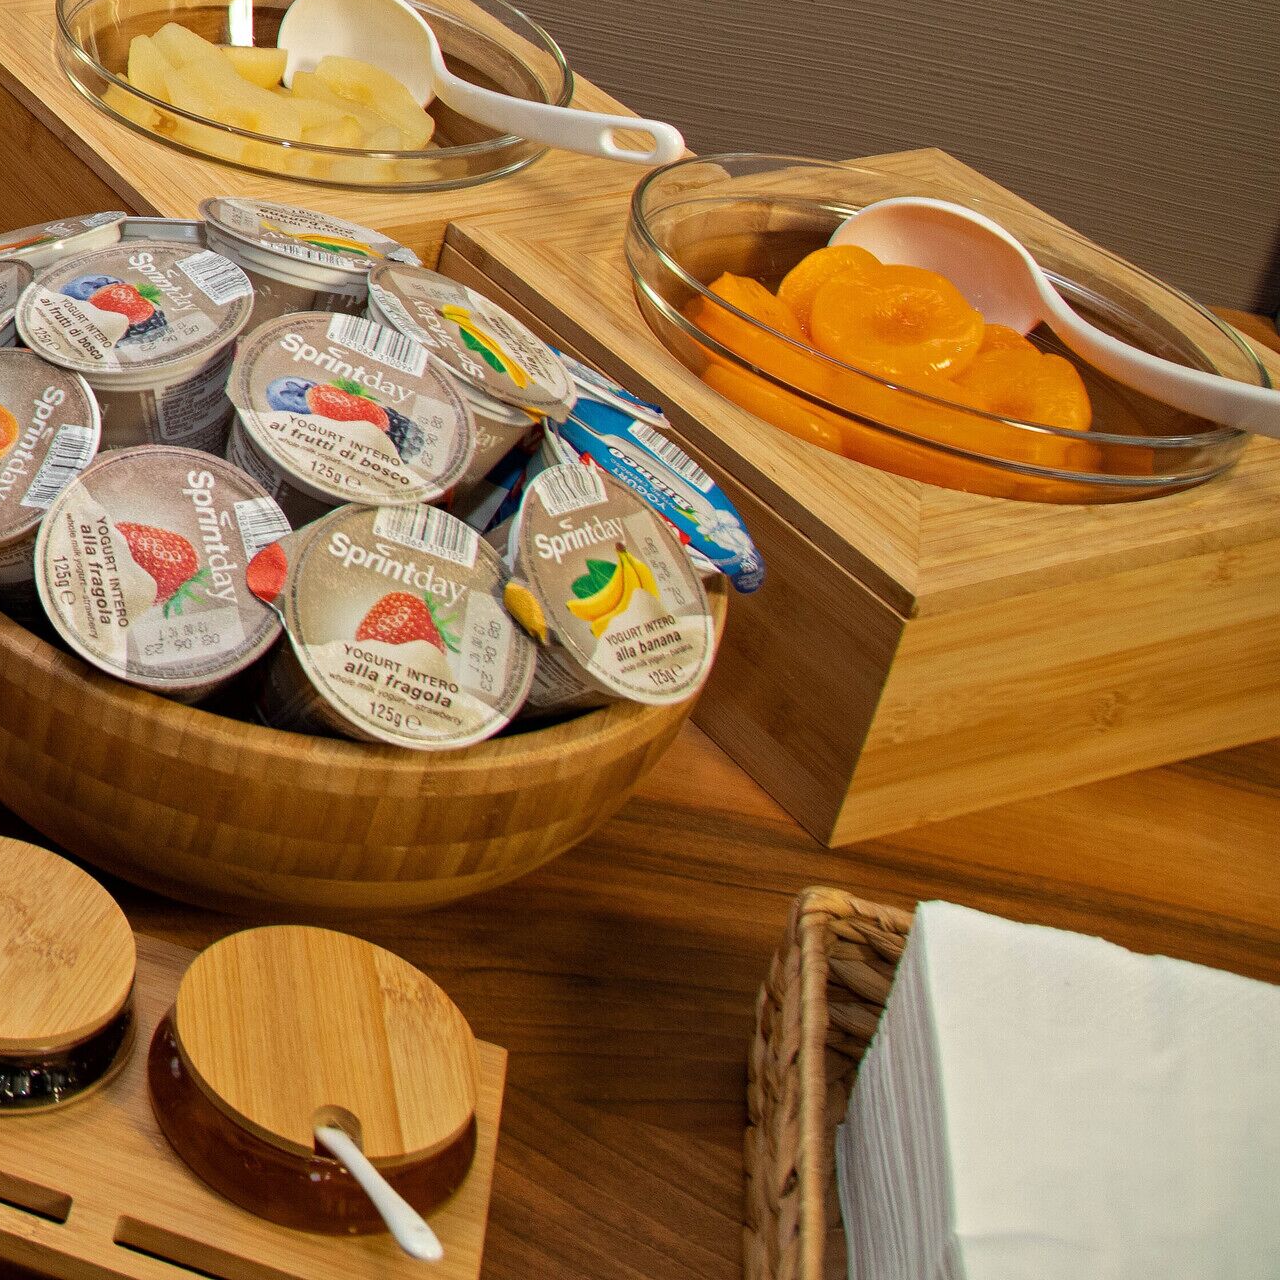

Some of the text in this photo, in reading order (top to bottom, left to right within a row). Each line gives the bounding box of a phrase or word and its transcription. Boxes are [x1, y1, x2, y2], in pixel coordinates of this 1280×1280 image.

[128, 252, 201, 312] Sprintday
[40, 297, 103, 360] ai frutti di bosco
[61, 297, 88, 326] YOGURT
[86, 321, 112, 349] INTERO
[280, 332, 416, 404] Sprintday
[269, 420, 410, 486] ai frutti di bosco
[289, 414, 401, 467] YOGURT INTERO
[309, 460, 343, 484] 125g
[608, 446, 693, 510] Bianco
[613, 467, 667, 511] YOGURT
[182, 470, 238, 604] Sprintday
[535, 516, 627, 564] Sprintday
[53, 556, 71, 592] 125g
[80, 524, 111, 625] alla fragola
[96, 515, 129, 628] YOGURT INTERO
[328, 532, 467, 607] Sprintday
[606, 614, 676, 646] YOGURT INTERO
[616, 630, 682, 662] alla banana
[344, 644, 459, 694] YOGURT INTERO
[344, 662, 452, 708] alla fragola
[649, 667, 674, 686] 125g
[370, 701, 402, 728] 125g
